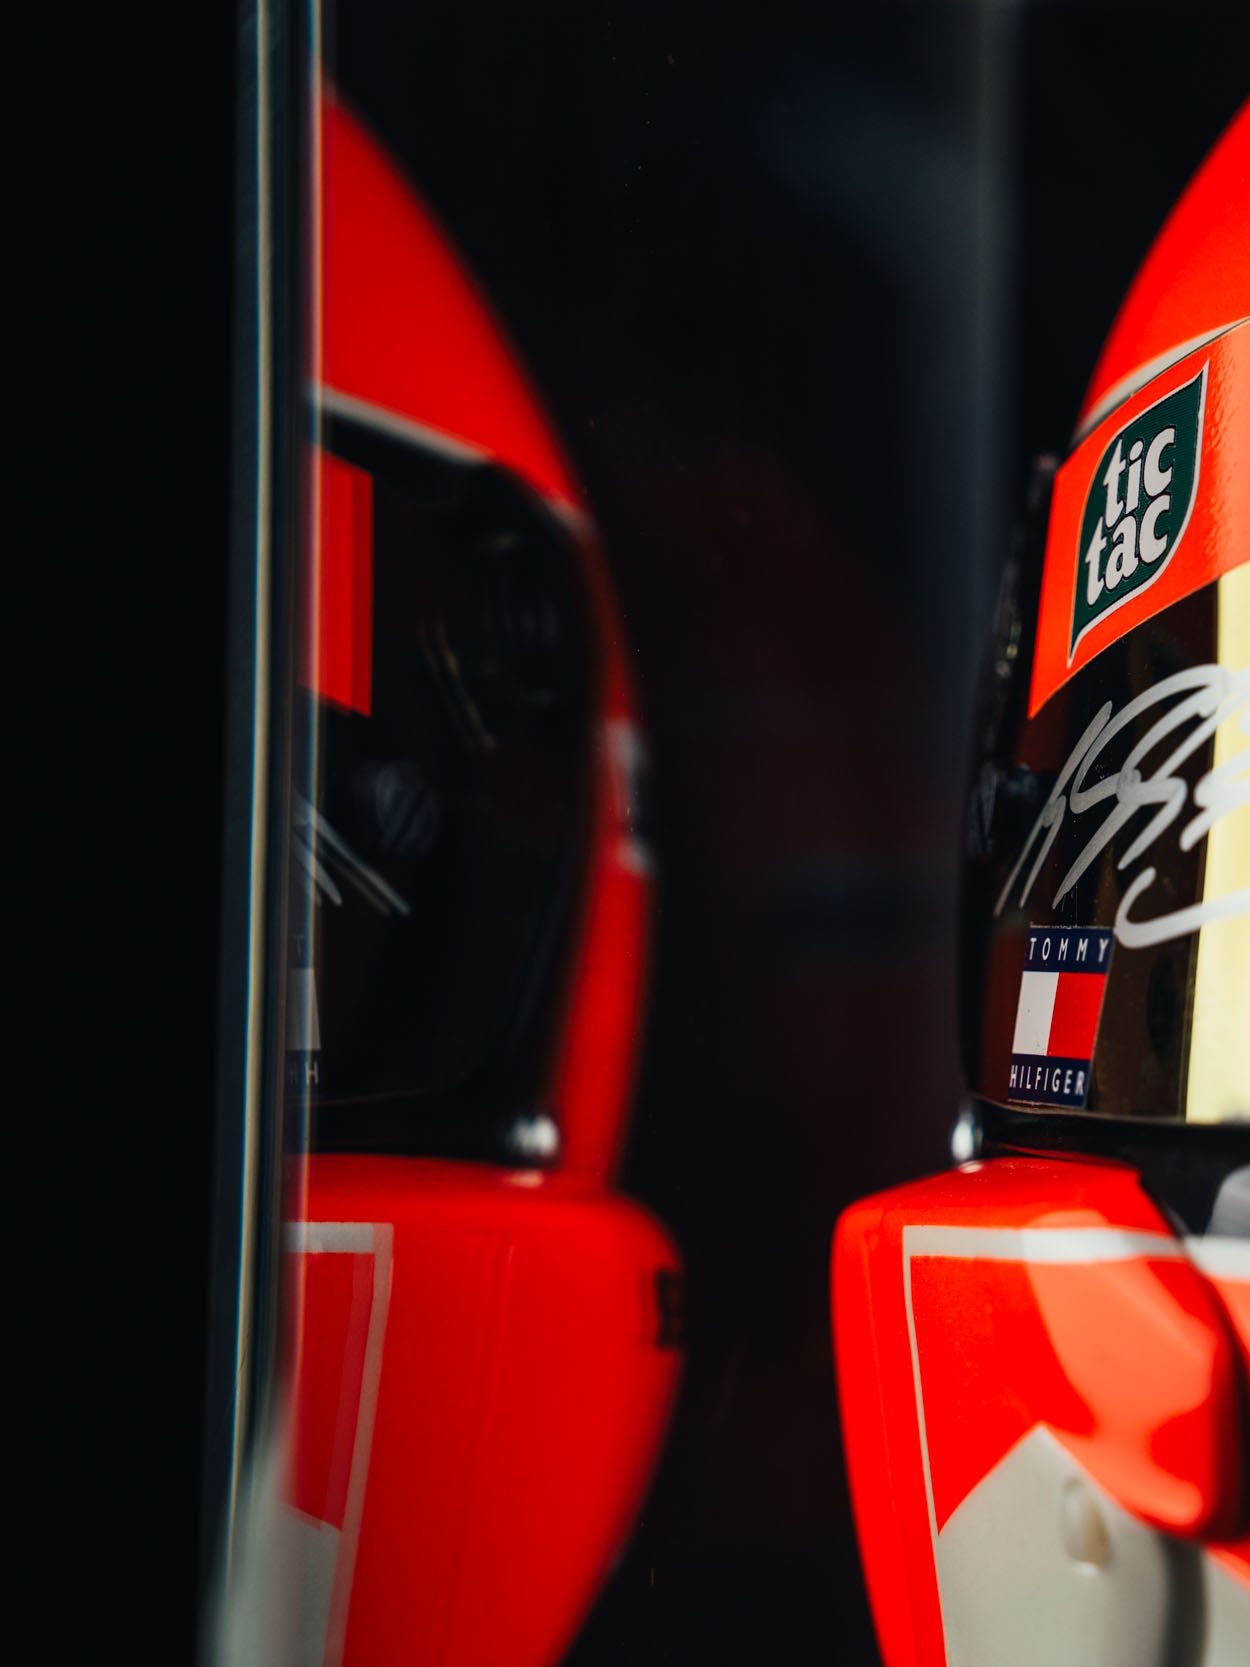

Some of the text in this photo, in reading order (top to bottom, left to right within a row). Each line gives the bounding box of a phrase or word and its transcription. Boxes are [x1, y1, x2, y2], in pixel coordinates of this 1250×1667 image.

[1103, 427, 1176, 527] tic
[1085, 495, 1170, 605] tac
[1028, 937, 1109, 962] TOMMY
[1009, 1065, 1086, 1096] HILFIGER
